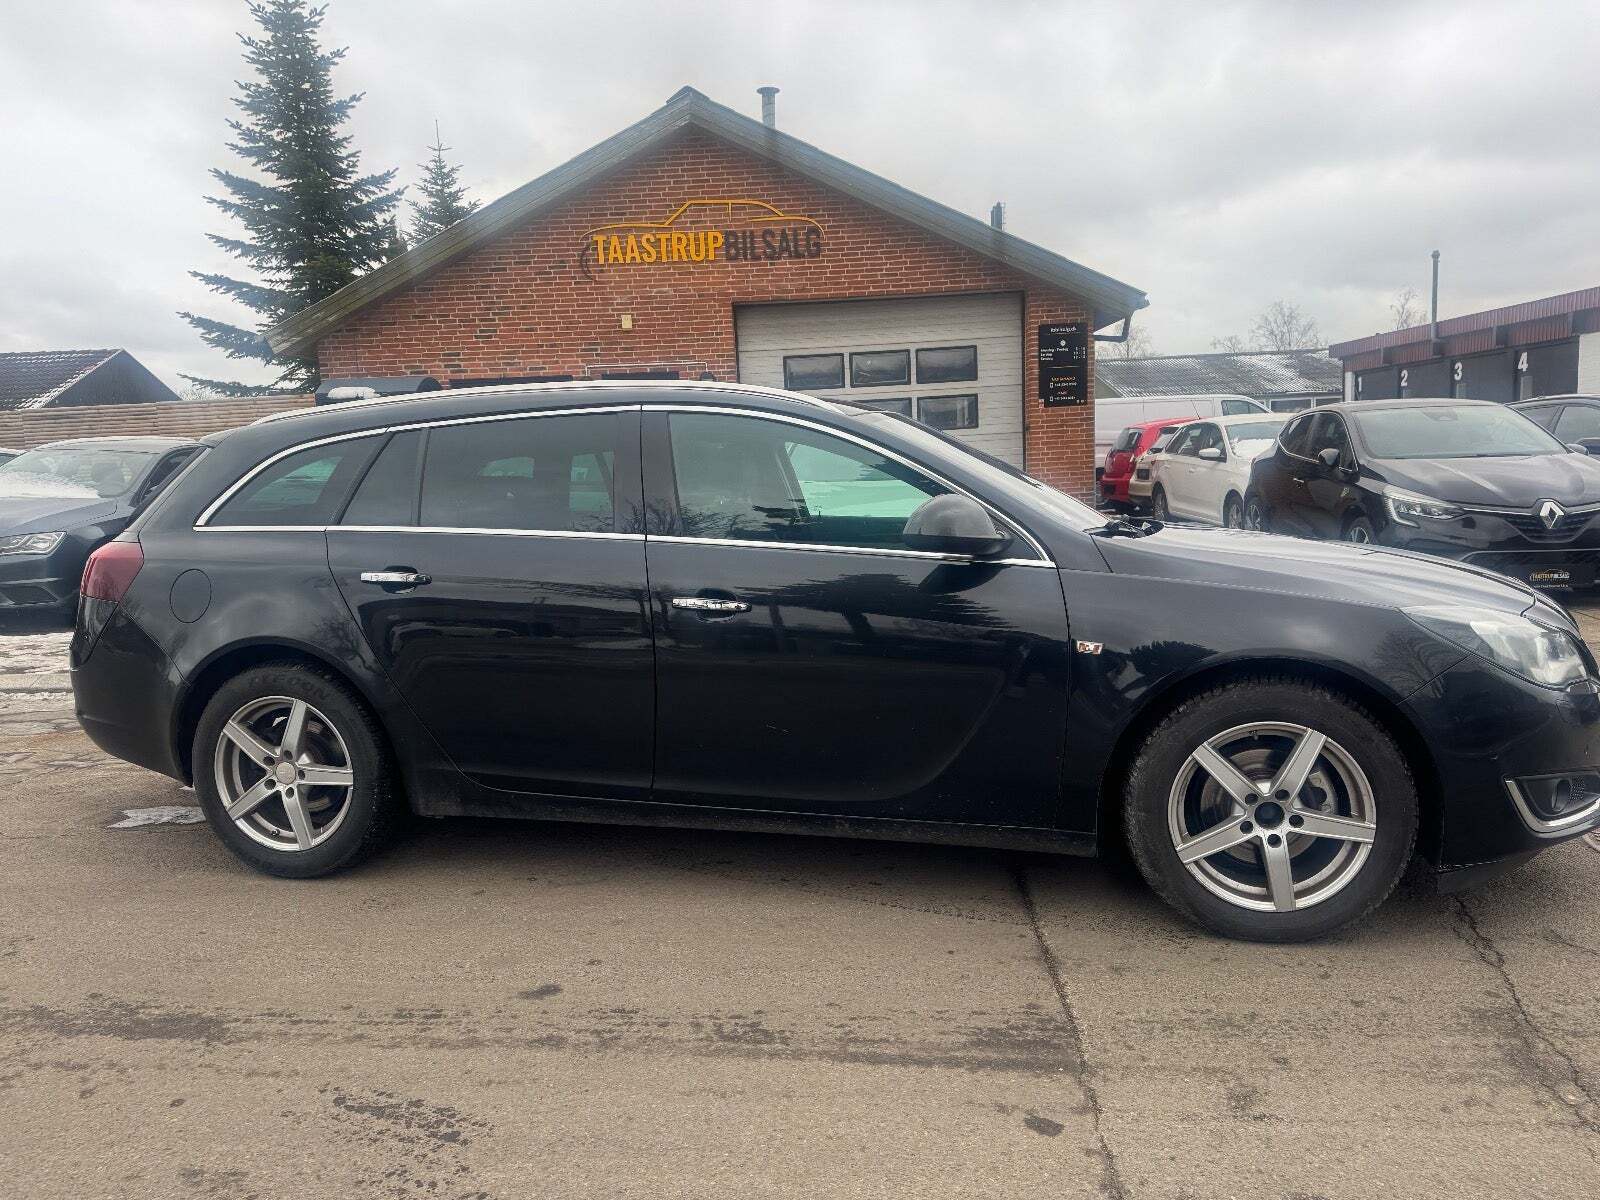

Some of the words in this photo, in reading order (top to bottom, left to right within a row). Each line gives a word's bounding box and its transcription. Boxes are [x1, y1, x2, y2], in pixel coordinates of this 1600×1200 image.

[1517, 352, 1529, 372] 4
[1400, 370, 1408, 387] 2
[1454, 362, 1463, 381] 3
[1357, 376, 1362, 392] 1
